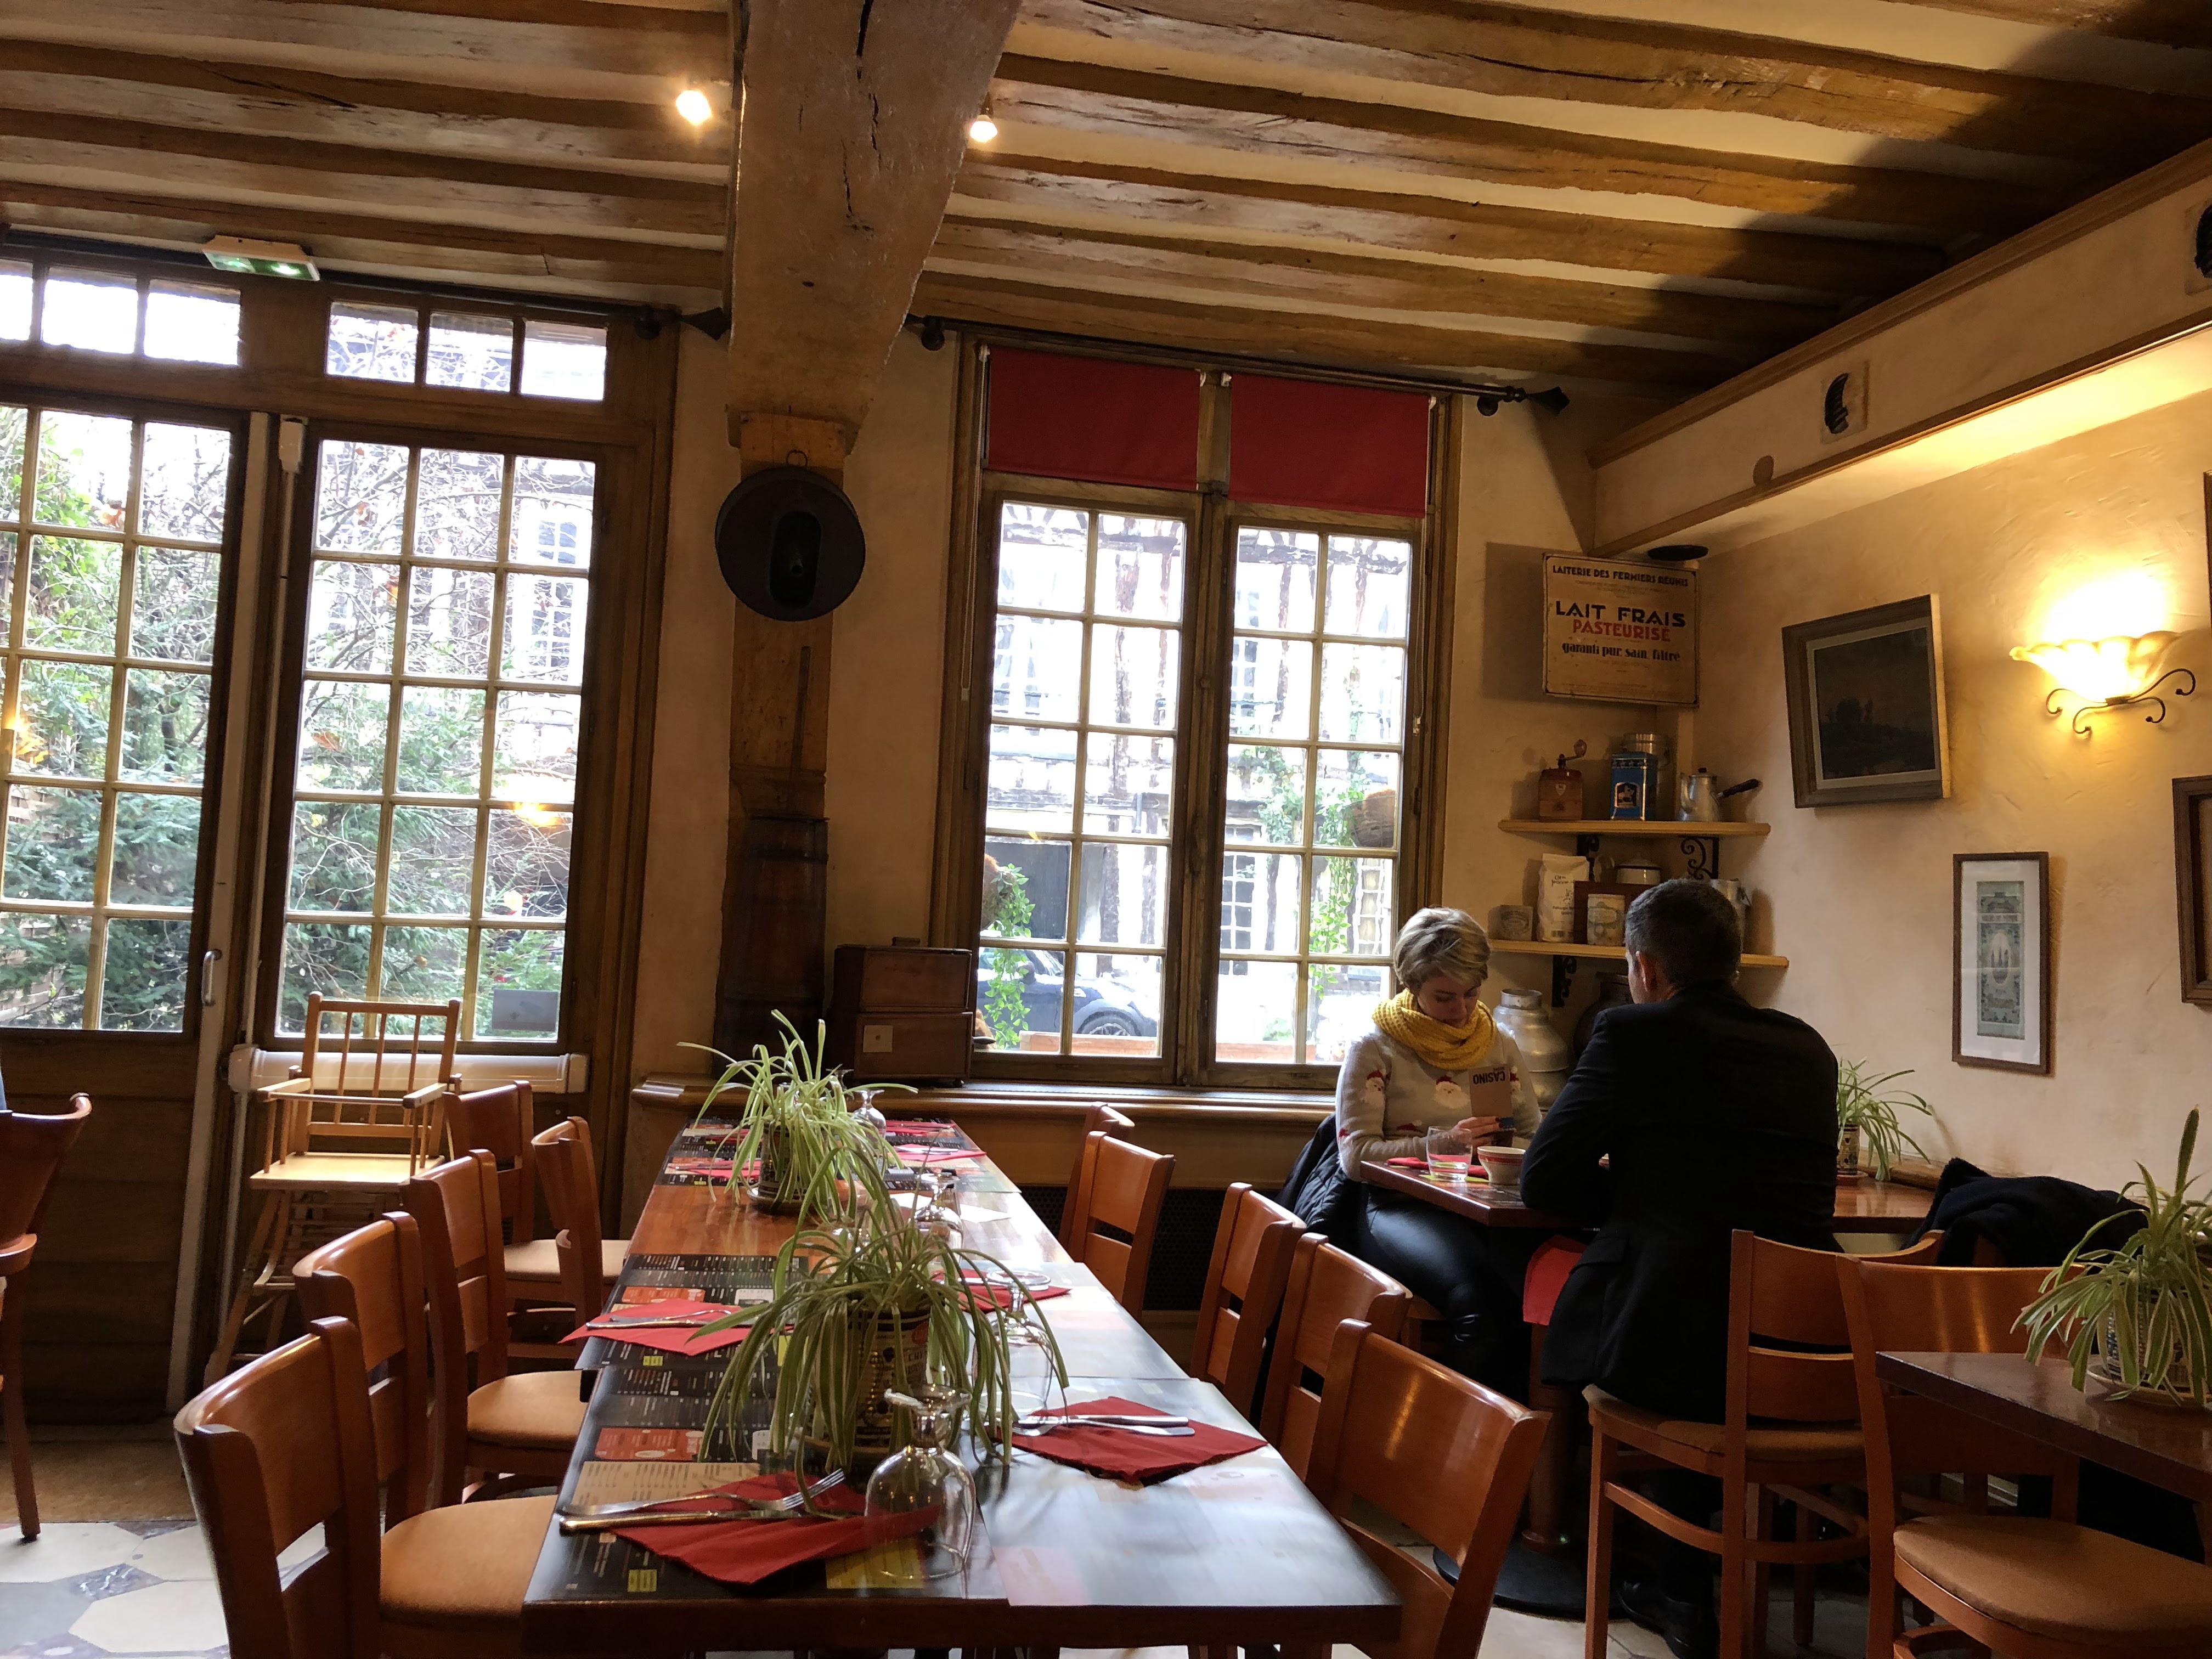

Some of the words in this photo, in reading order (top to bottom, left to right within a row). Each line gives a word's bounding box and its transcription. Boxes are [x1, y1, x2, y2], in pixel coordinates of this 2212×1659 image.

[1553, 565, 1591, 577] LAITERIE
[1593, 569, 1609, 579] DES
[1613, 571, 1656, 584] FERMIERS
[1556, 601, 1606, 620] LAIT
[1618, 607, 1686, 627] FRAIS
[1562, 642, 1599, 655] garanti
[1602, 646, 1622, 657] pur
[1625, 648, 1647, 659] sain
[1473, 1071, 1505, 1084] CASINO
